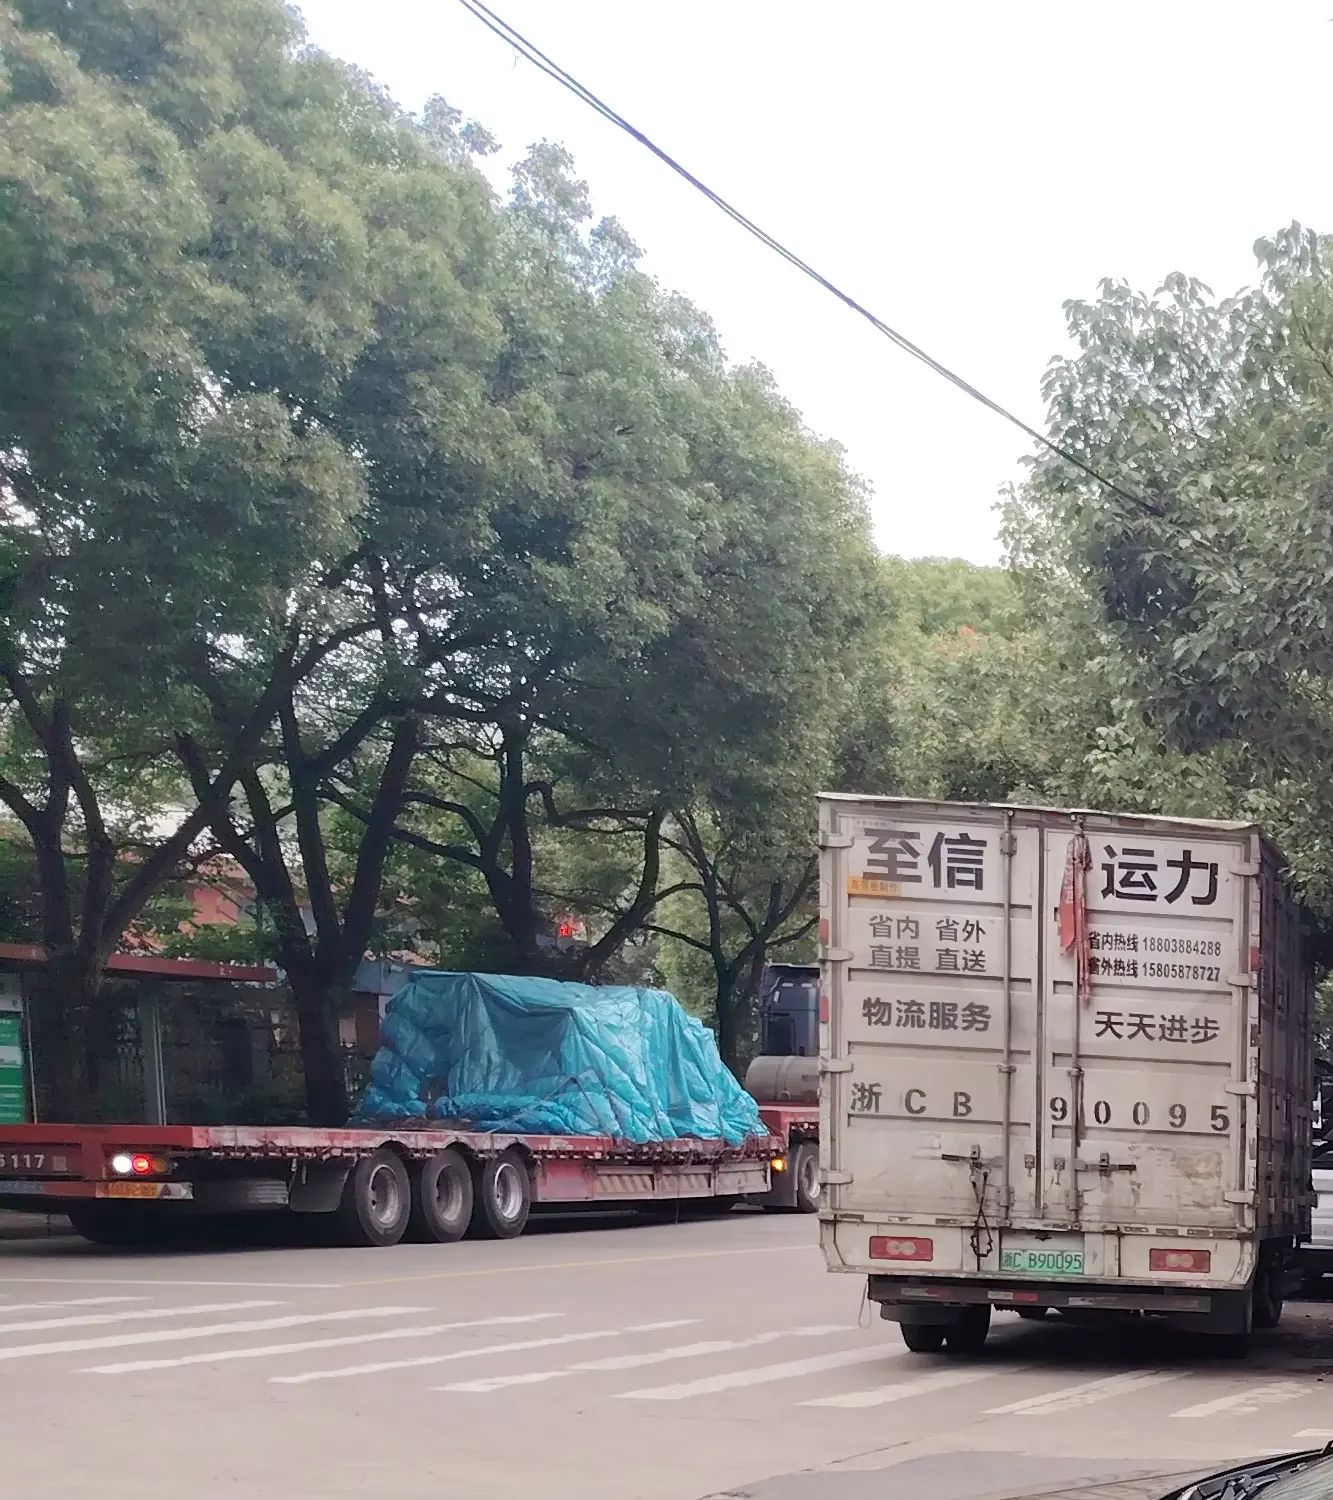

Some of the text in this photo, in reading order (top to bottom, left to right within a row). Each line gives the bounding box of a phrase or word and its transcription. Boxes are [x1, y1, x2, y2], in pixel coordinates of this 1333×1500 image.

[862, 827, 1219, 906] 至信 运力
[868, 914, 987, 943] 省内 省外
[1088, 930, 1139, 953] 省内热线
[868, 944, 987, 973] 直提 直送
[1088, 956, 1139, 979] 省外热线
[862, 996, 992, 1032] 物流服务
[1094, 1010, 1221, 1045] 天天进步
